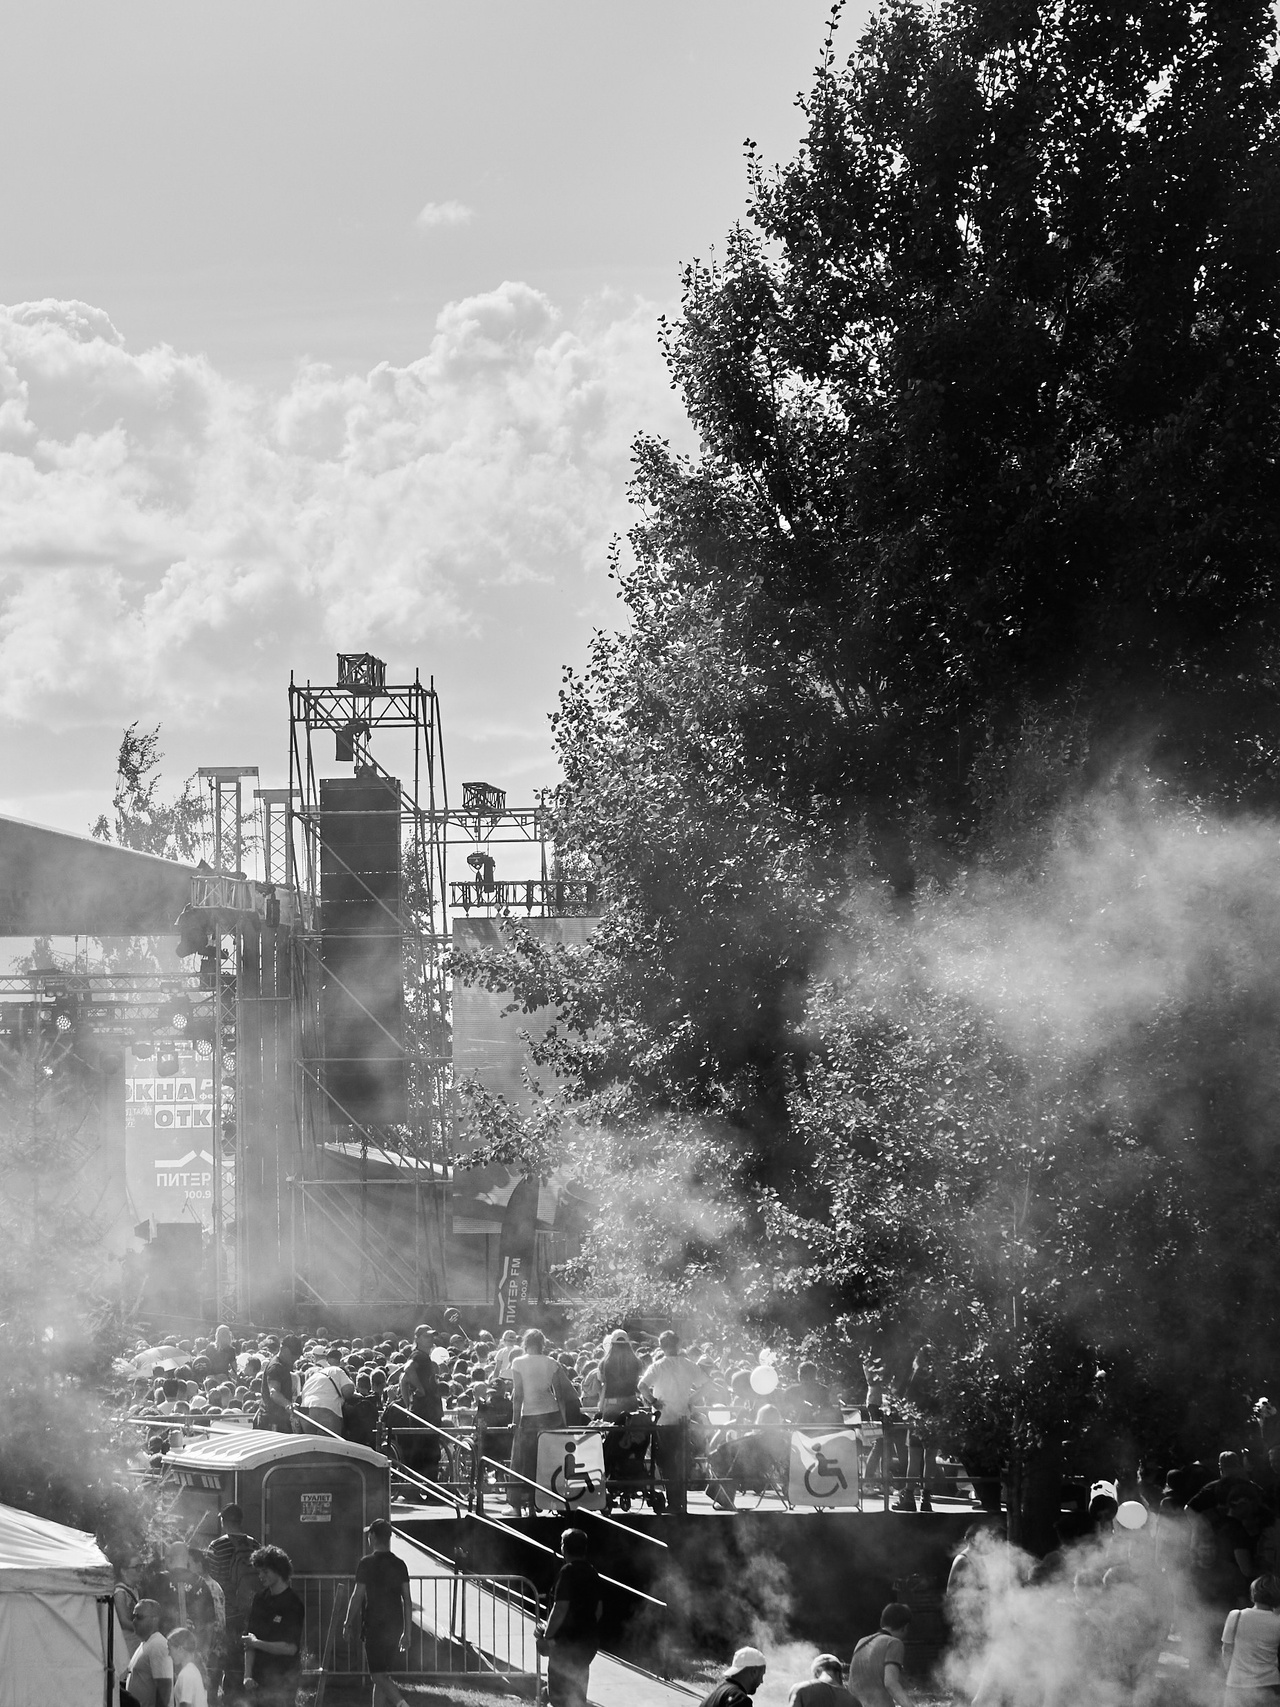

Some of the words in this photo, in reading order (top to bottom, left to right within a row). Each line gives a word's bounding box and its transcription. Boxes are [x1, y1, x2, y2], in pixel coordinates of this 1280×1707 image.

[155, 1109, 213, 1127] ОТК
[156, 1172, 212, 1187] ПИТЕР
[184, 1190, 212, 1199] 100.9
[510, 1257, 521, 1276] FM
[506, 1280, 519, 1323] ПИТЕР
